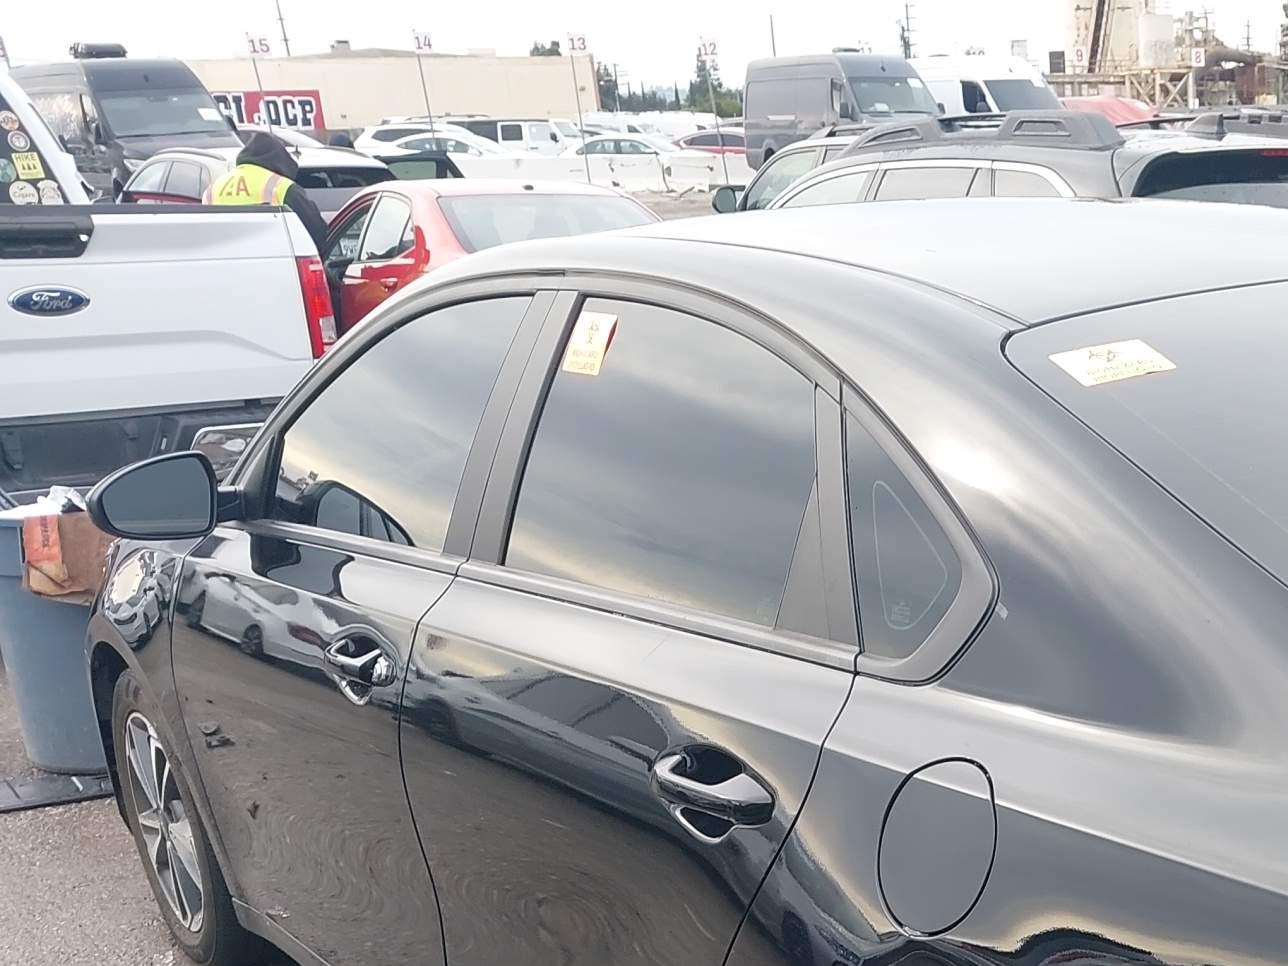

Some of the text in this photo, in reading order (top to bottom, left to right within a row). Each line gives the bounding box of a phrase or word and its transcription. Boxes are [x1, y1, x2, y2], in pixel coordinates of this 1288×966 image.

[248, 38, 270, 54] 15
[415, 35, 433, 50] 14
[569, 37, 587, 51] 13
[702, 42, 718, 56] 12
[1075, 49, 1084, 63] 9
[1195, 50, 1202, 64] 8
[14, 152, 37, 162] HIKE
[30, 291, 74, 310] Ford
